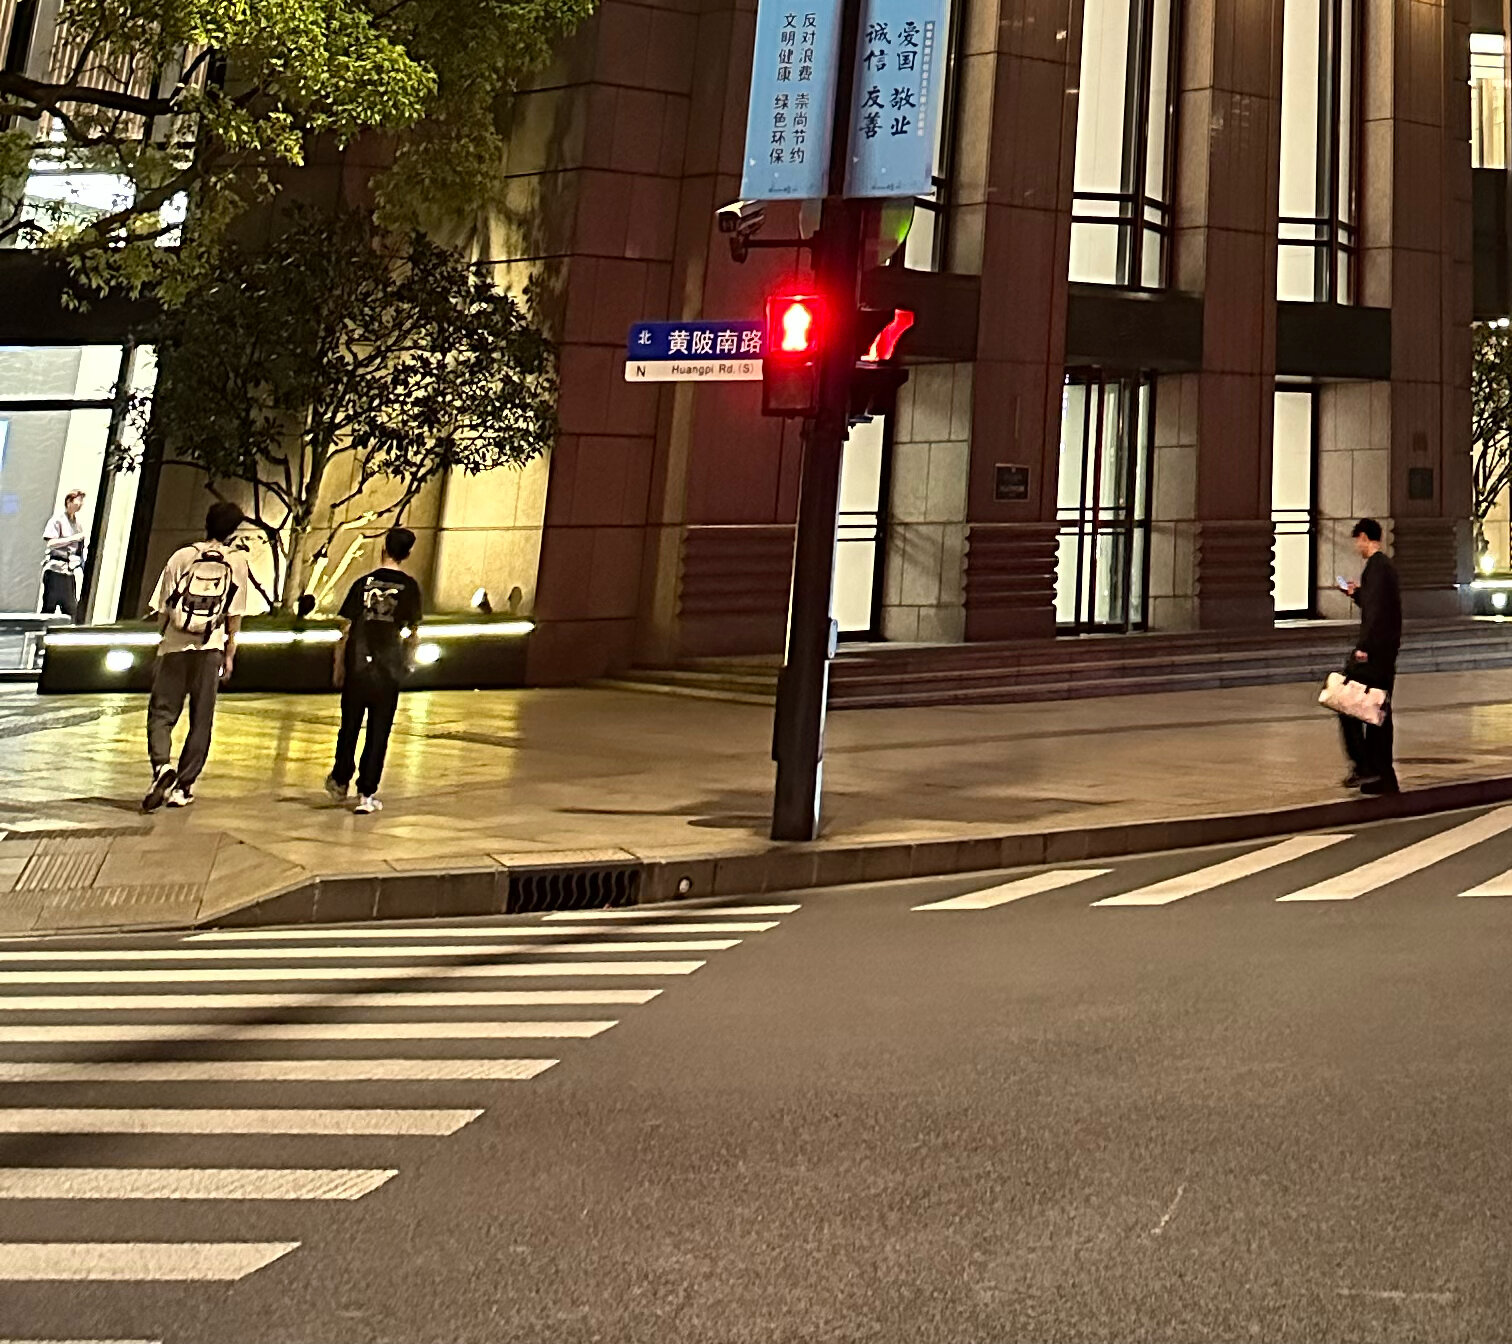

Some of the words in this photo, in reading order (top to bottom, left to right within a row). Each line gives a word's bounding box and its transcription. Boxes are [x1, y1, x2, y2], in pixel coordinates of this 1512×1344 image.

[776, 13, 798, 83] 文明健康
[798, 13, 817, 82] 反对浪费
[863, 21, 892, 72] 诚信
[896, 20, 920, 72] 爱国
[769, 94, 789, 165] 绿色环保
[788, 93, 811, 165] 崇尚节约
[859, 85, 885, 140] 友善
[889, 86, 917, 137] 敬业
[637, 330, 652, 345] 北
[668, 329, 763, 355] 黄陂南路
[636, 365, 646, 377] N
[671, 364, 714, 377] Huangpi
